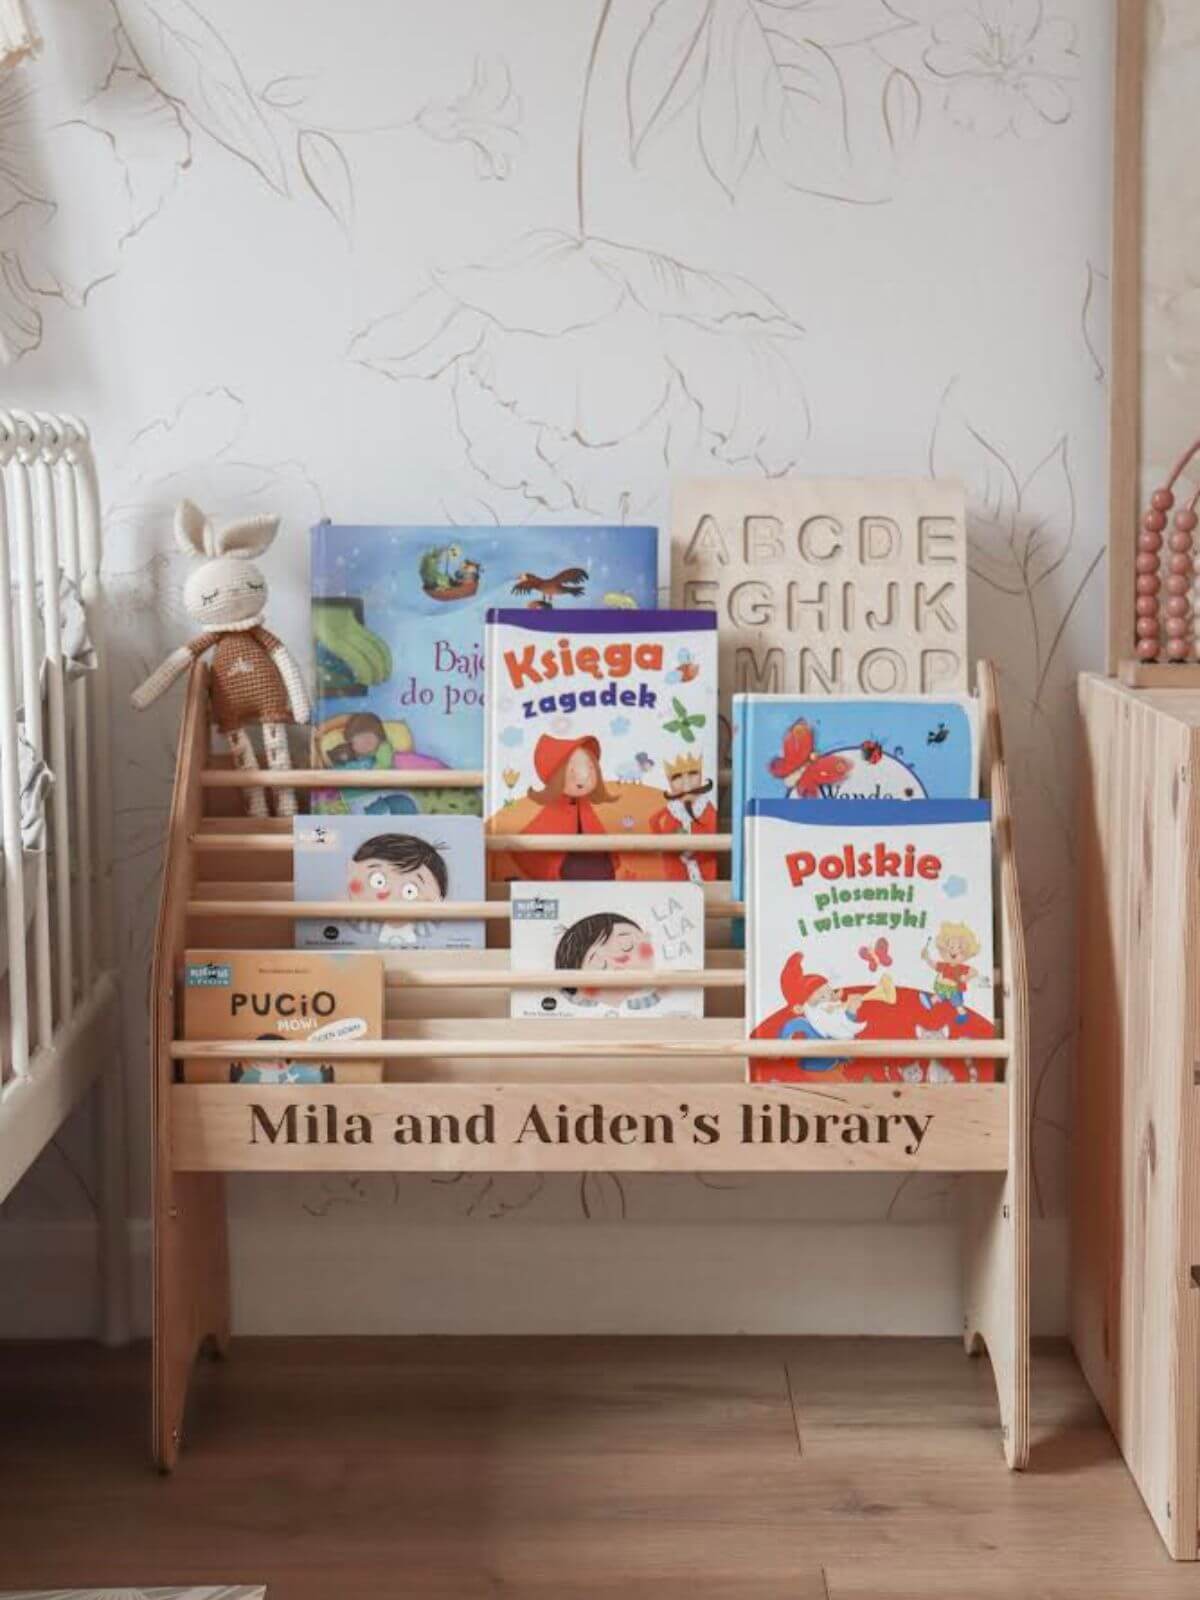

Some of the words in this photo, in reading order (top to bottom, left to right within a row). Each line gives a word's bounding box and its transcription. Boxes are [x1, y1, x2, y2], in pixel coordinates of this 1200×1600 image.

[503, 638, 664, 690] Księga
[400, 676, 434, 706] do
[522, 682, 657, 719] zagadek
[786, 842, 942, 888] Polskie
[814, 883, 914, 911] piosenki
[797, 919, 808, 937] i
[813, 909, 928, 933] wierszyki
[246, 1103, 374, 1145] Mila
[393, 1103, 497, 1145] and
[512, 1103, 722, 1145] Aiden’s
[740, 1103, 936, 1155] library
